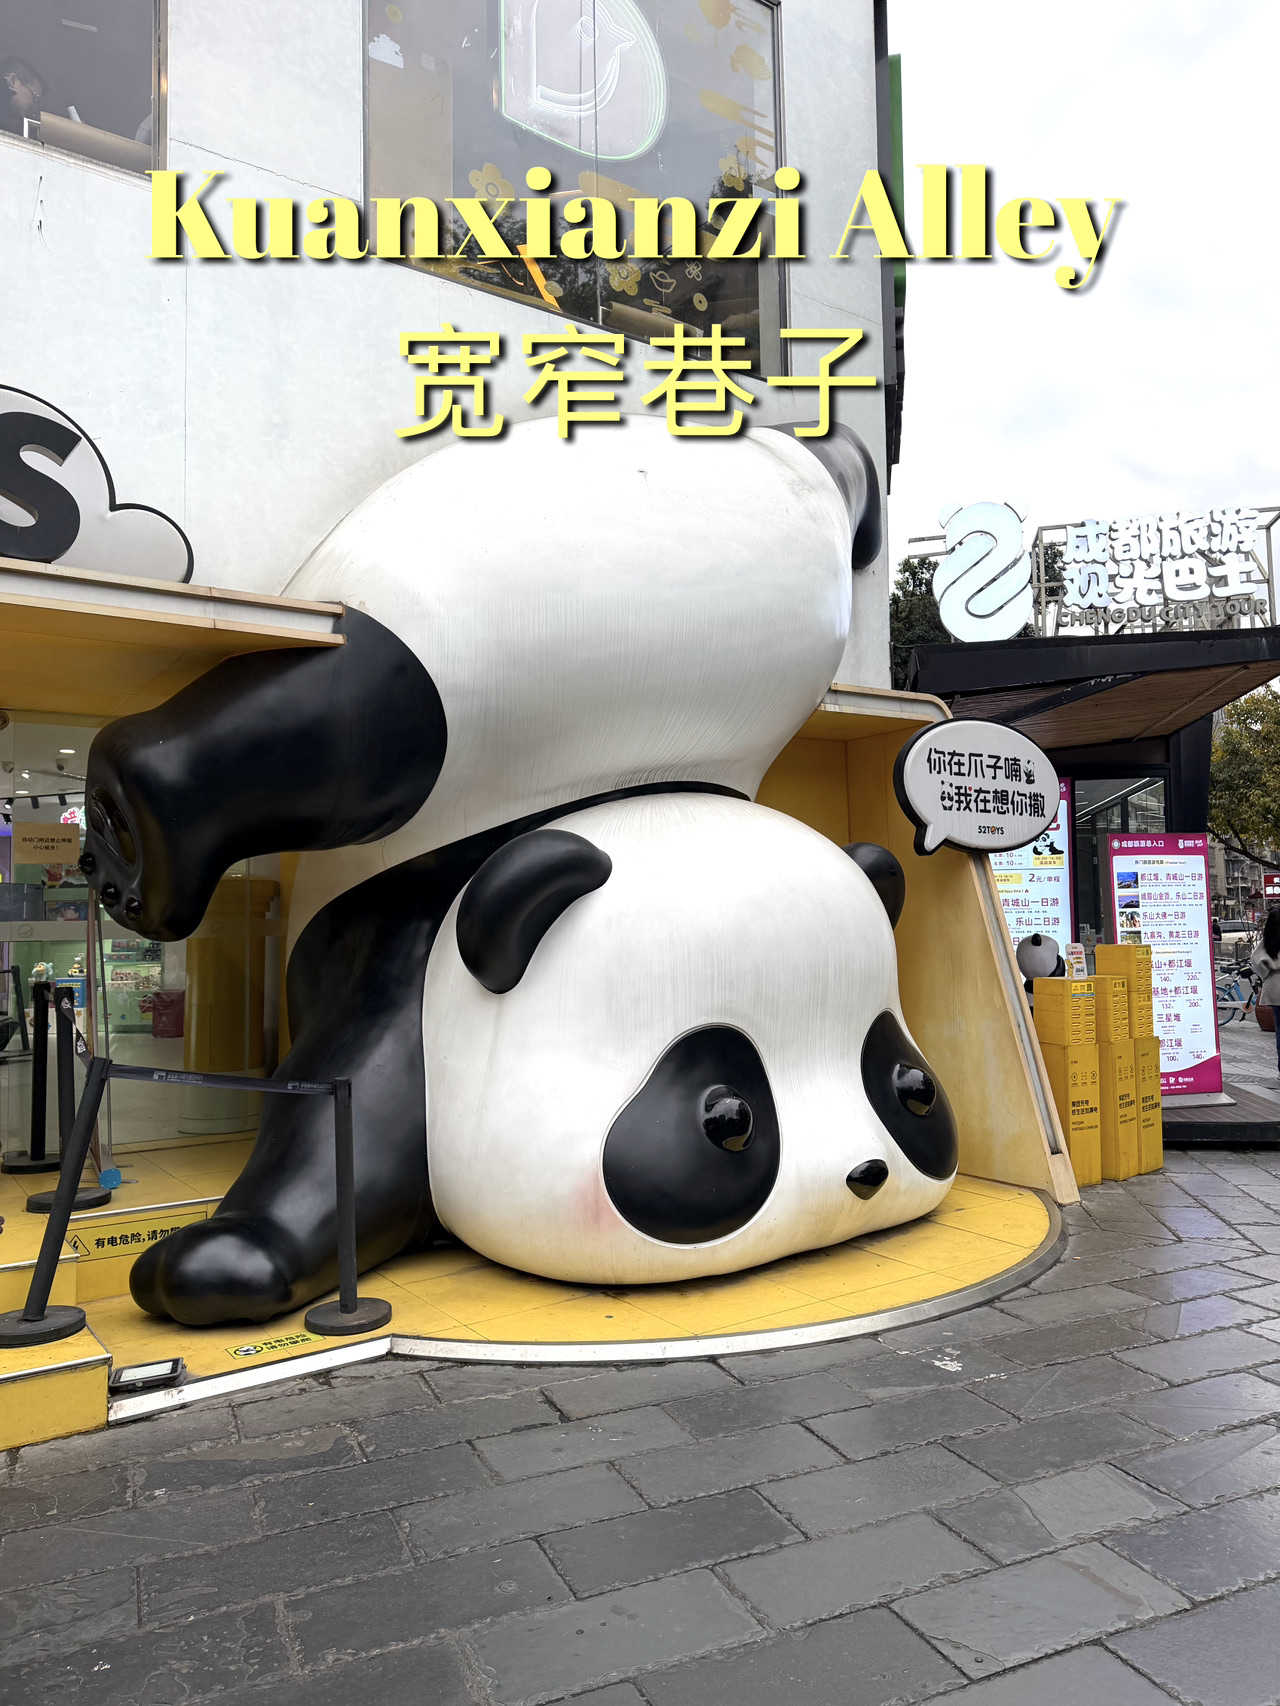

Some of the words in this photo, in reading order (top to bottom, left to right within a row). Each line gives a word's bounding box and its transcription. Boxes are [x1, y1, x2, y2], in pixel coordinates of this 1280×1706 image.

[1062, 507, 1260, 563] 成都旅游
[1062, 553, 1260, 609] 观光巴士
[1211, 599, 1268, 618] TOUR
[954, 786, 1046, 818] 我在想你撒
[94, 1226, 180, 1249] 有电危险,请勿
